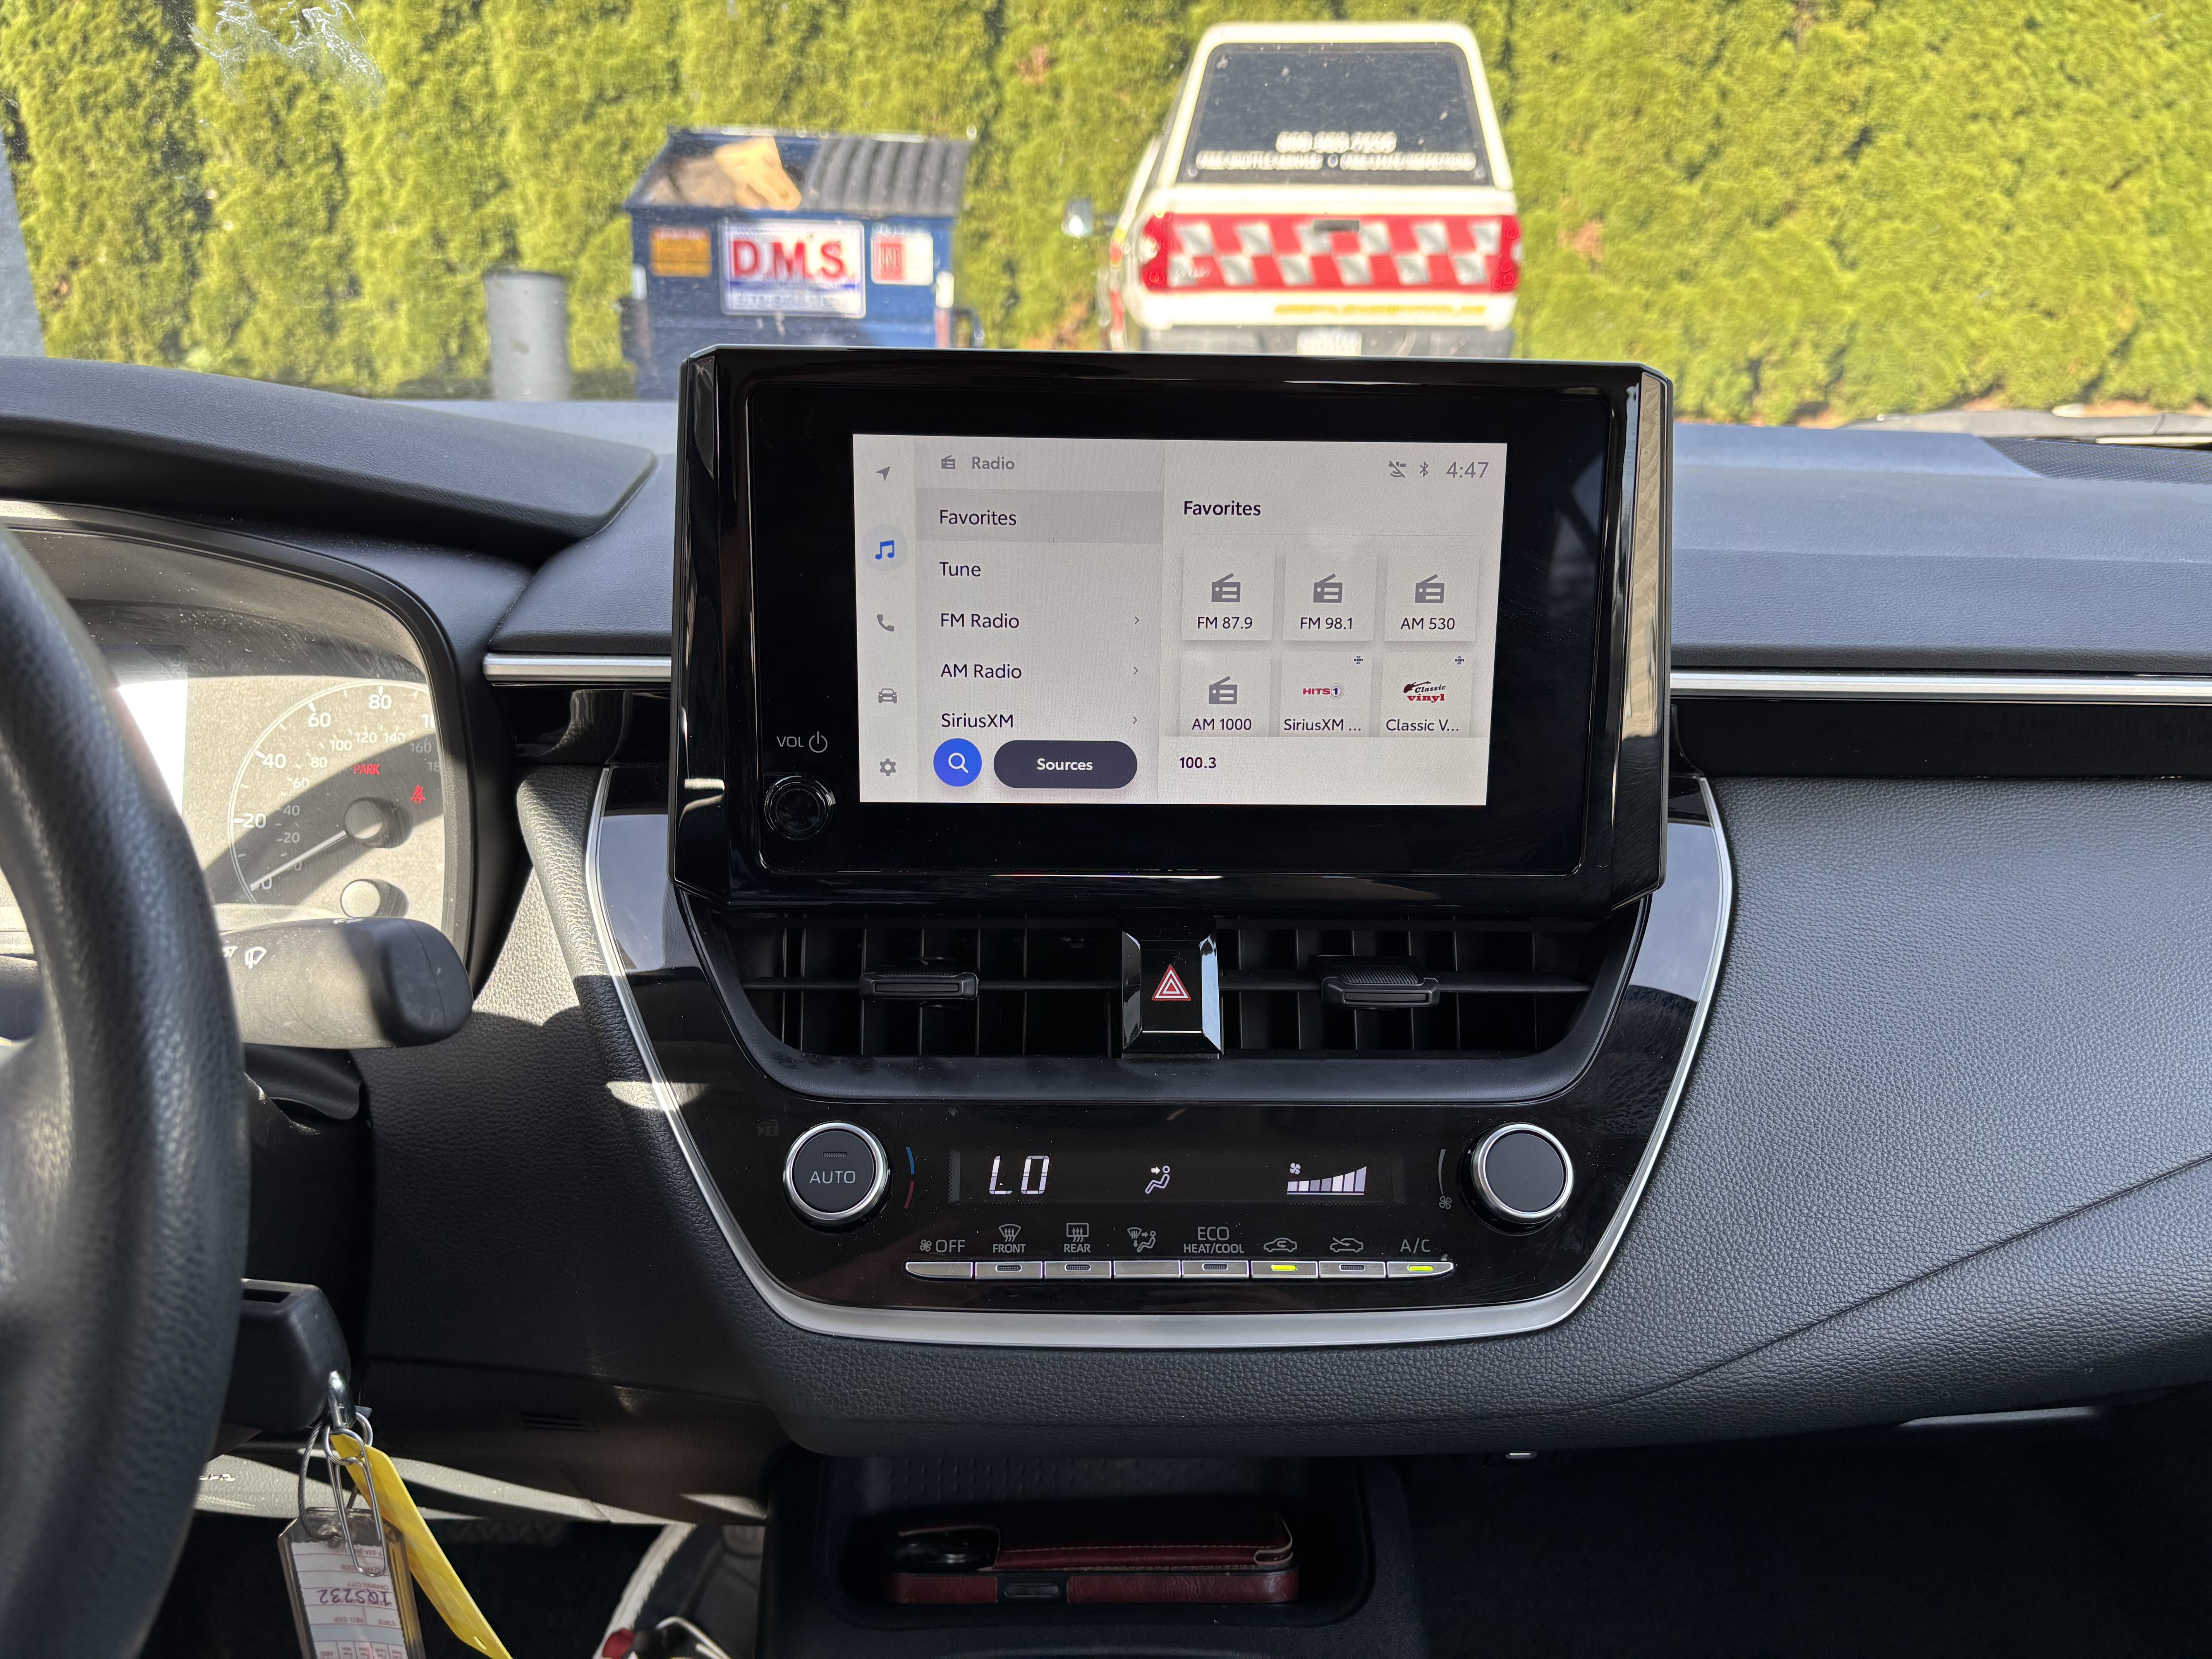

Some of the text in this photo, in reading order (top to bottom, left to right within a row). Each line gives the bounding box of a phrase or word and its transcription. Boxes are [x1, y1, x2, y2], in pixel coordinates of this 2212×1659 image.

[972, 456, 1015, 470] Radio
[1446, 461, 1489, 478] 4:47
[1184, 500, 1261, 516] Favorites
[940, 509, 1017, 526] Favorites
[939, 562, 981, 577] Tune
[941, 613, 1019, 629] FM Radio
[1197, 617, 1253, 629] FM 87.9
[1300, 617, 1352, 630] FM 98.1
[1400, 617, 1455, 630] AM 530
[940, 663, 1022, 679] AM Radio
[1415, 684, 1446, 693] Classic
[368, 695, 392, 709] 80
[1407, 694, 1445, 703] vinyl
[308, 712, 331, 727] 60
[941, 713, 1013, 728] SiriusXM
[1192, 718, 1252, 730] AM 1000
[1284, 718, 1344, 731] SiriusXM
[1386, 718, 1435, 731] Classic
[355, 732, 377, 744] 120
[383, 732, 406, 744] 140
[776, 736, 804, 747] VOL
[330, 739, 352, 751] 100
[409, 742, 432, 753] 160
[263, 754, 286, 769] 40
[310, 757, 328, 768] 80
[1037, 758, 1093, 771] Sources
[1179, 757, 1216, 769] 100.3
[353, 764, 380, 775] PARK
[293, 778, 310, 789] 60
[283, 805, 300, 816] 40
[242, 814, 266, 828] 20
[283, 832, 300, 843] 20
[809, 1171, 855, 1184] AUTO
[989, 1155, 1050, 1195] LO
[1197, 1226, 1230, 1241] ECO
[935, 1239, 965, 1253] OFF
[993, 1243, 1026, 1253] FRONT
[1064, 1243, 1091, 1253] REAR
[1183, 1243, 1245, 1254] HEAT/COOL
[1400, 1238, 1431, 1254] A/C
